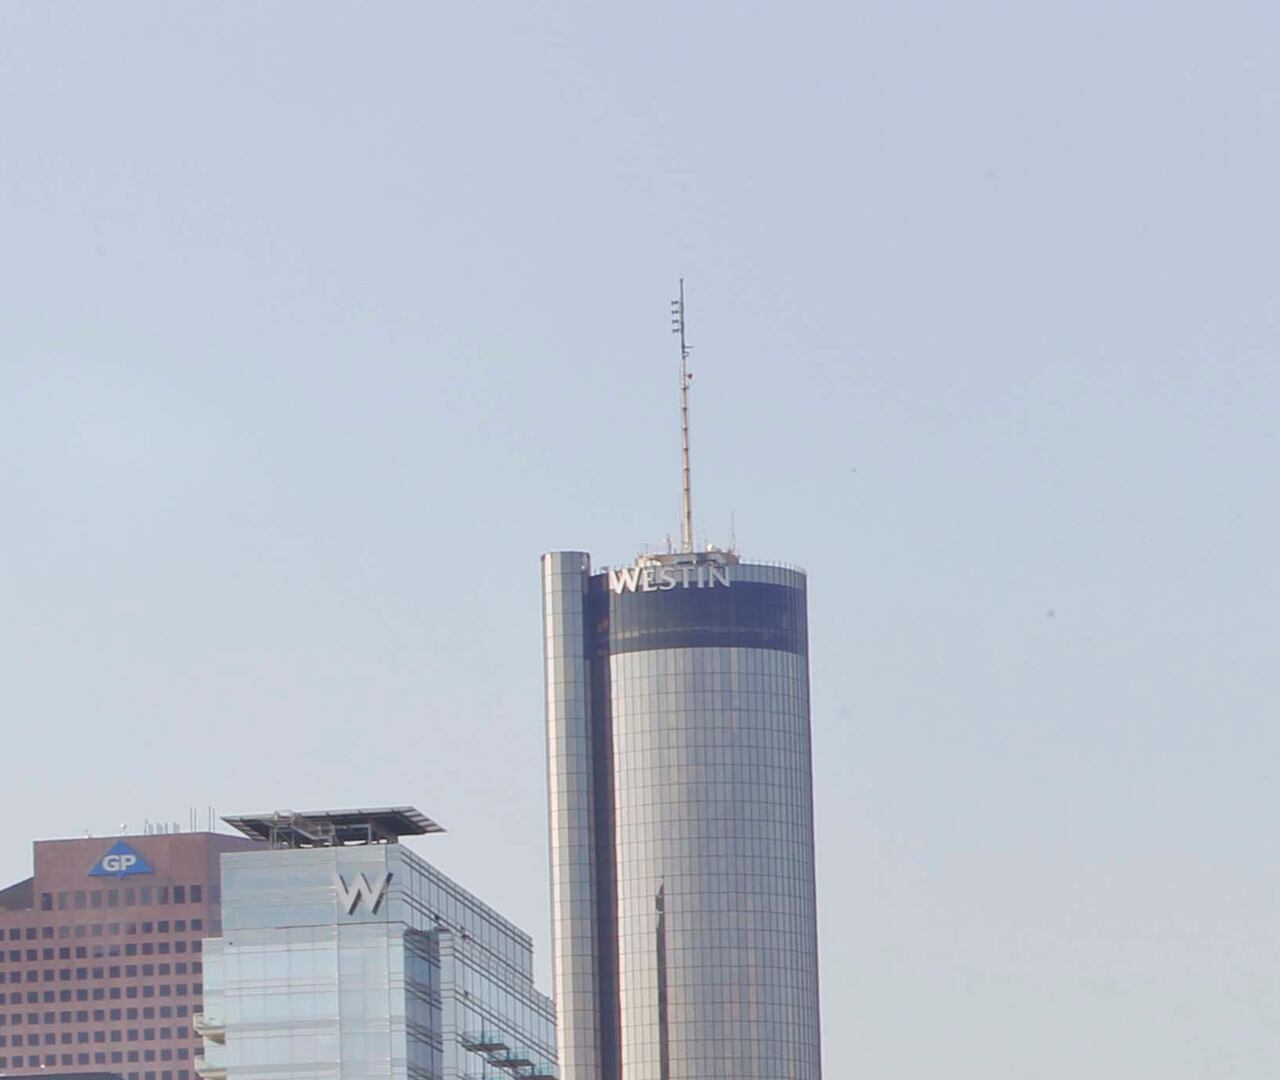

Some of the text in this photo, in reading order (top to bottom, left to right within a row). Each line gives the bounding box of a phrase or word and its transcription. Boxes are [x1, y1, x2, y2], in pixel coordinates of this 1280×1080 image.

[609, 565, 731, 594] WESTIN
[102, 854, 137, 872] GP
[335, 871, 394, 916] W
